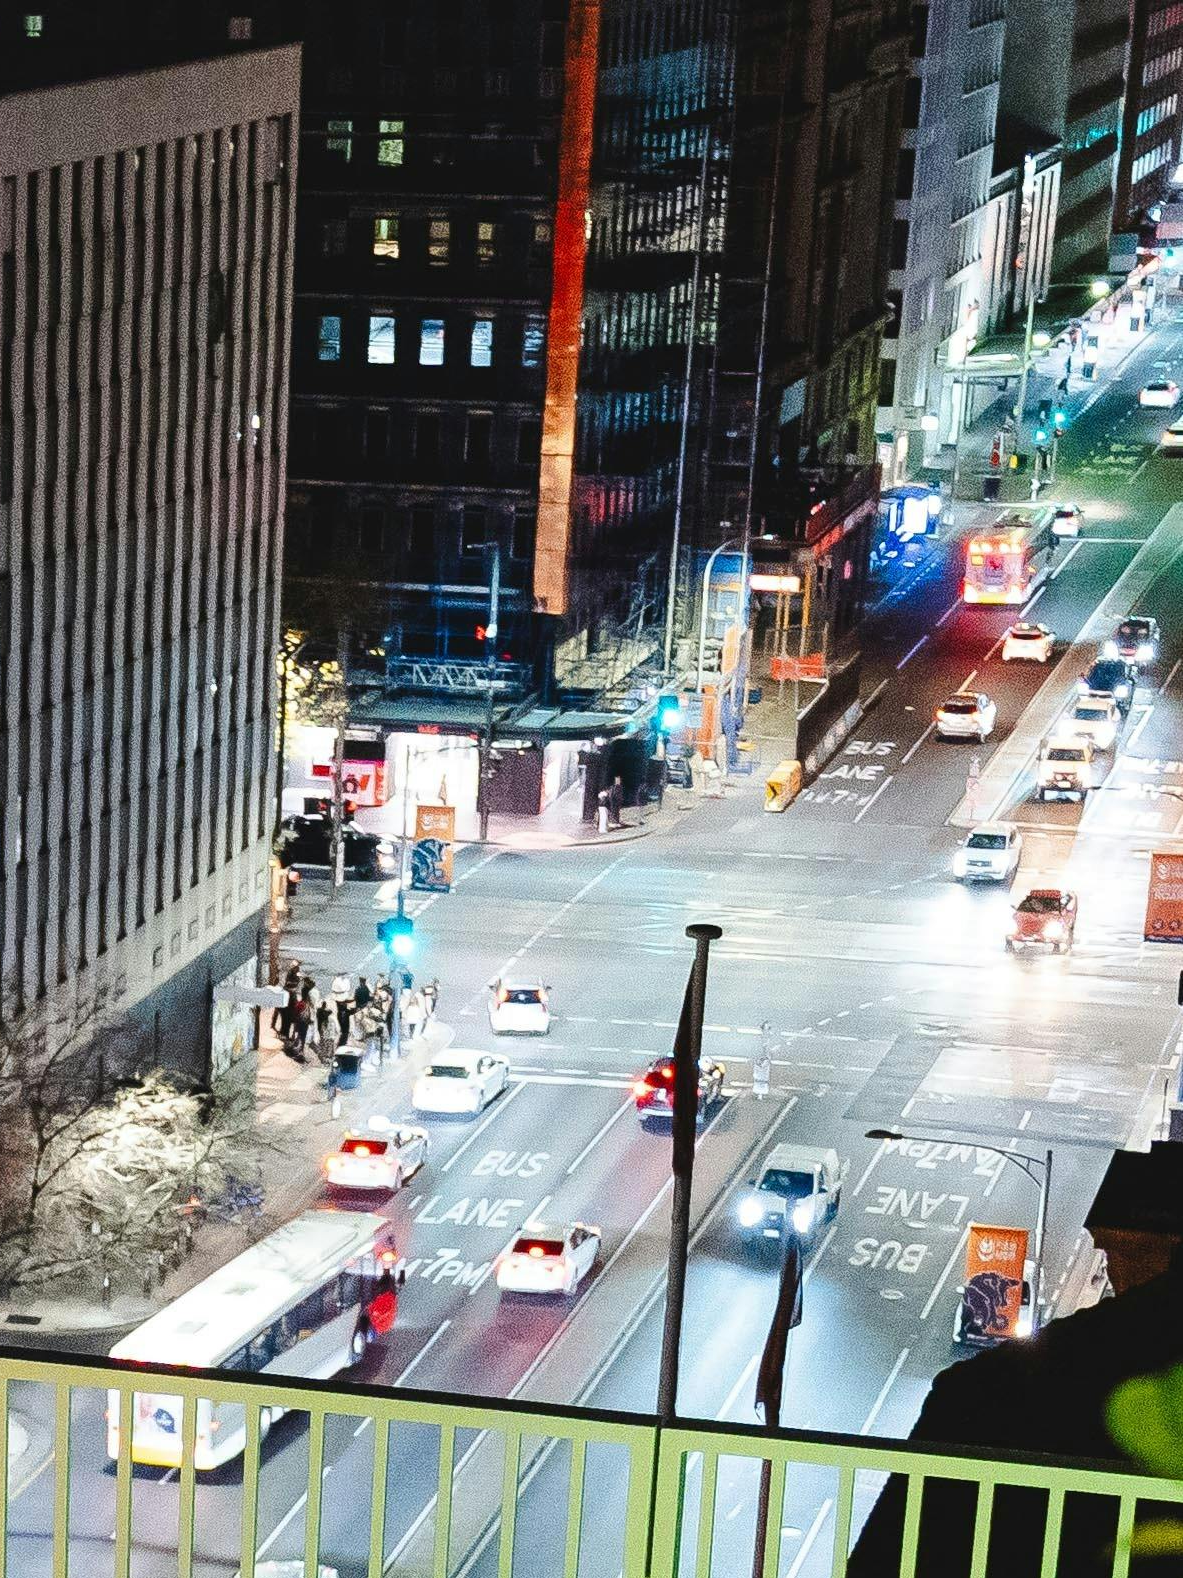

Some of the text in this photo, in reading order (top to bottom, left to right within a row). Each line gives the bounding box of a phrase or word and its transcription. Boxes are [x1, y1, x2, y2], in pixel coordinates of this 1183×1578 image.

[844, 740, 897, 756] BUS
[470, 1150, 551, 1178] BUS
[414, 1195, 524, 1228] LANE
[864, 1185, 971, 1224] LANE
[848, 1237, 929, 1273] BUS
